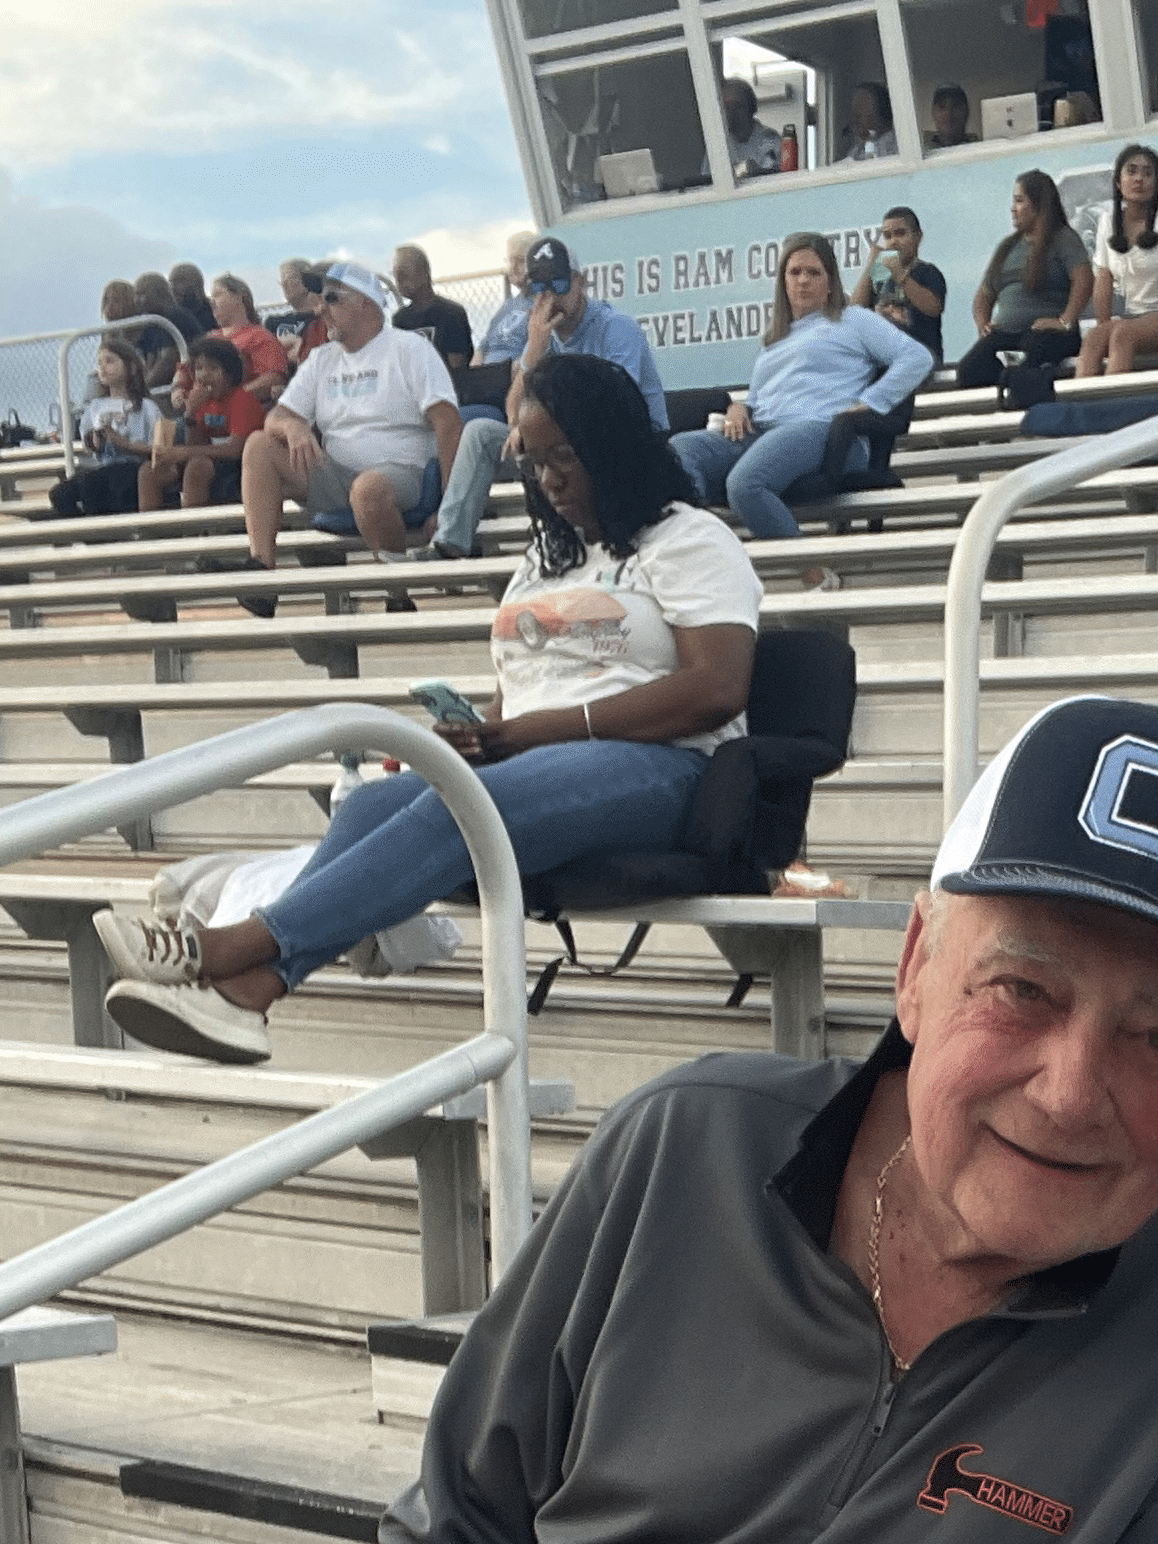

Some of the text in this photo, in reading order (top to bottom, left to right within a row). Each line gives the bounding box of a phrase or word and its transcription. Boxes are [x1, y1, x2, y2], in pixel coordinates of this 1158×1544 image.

[581, 228, 884, 299] HIS IS RAM COTRY
[976, 1477, 1067, 1530] HAMMER
